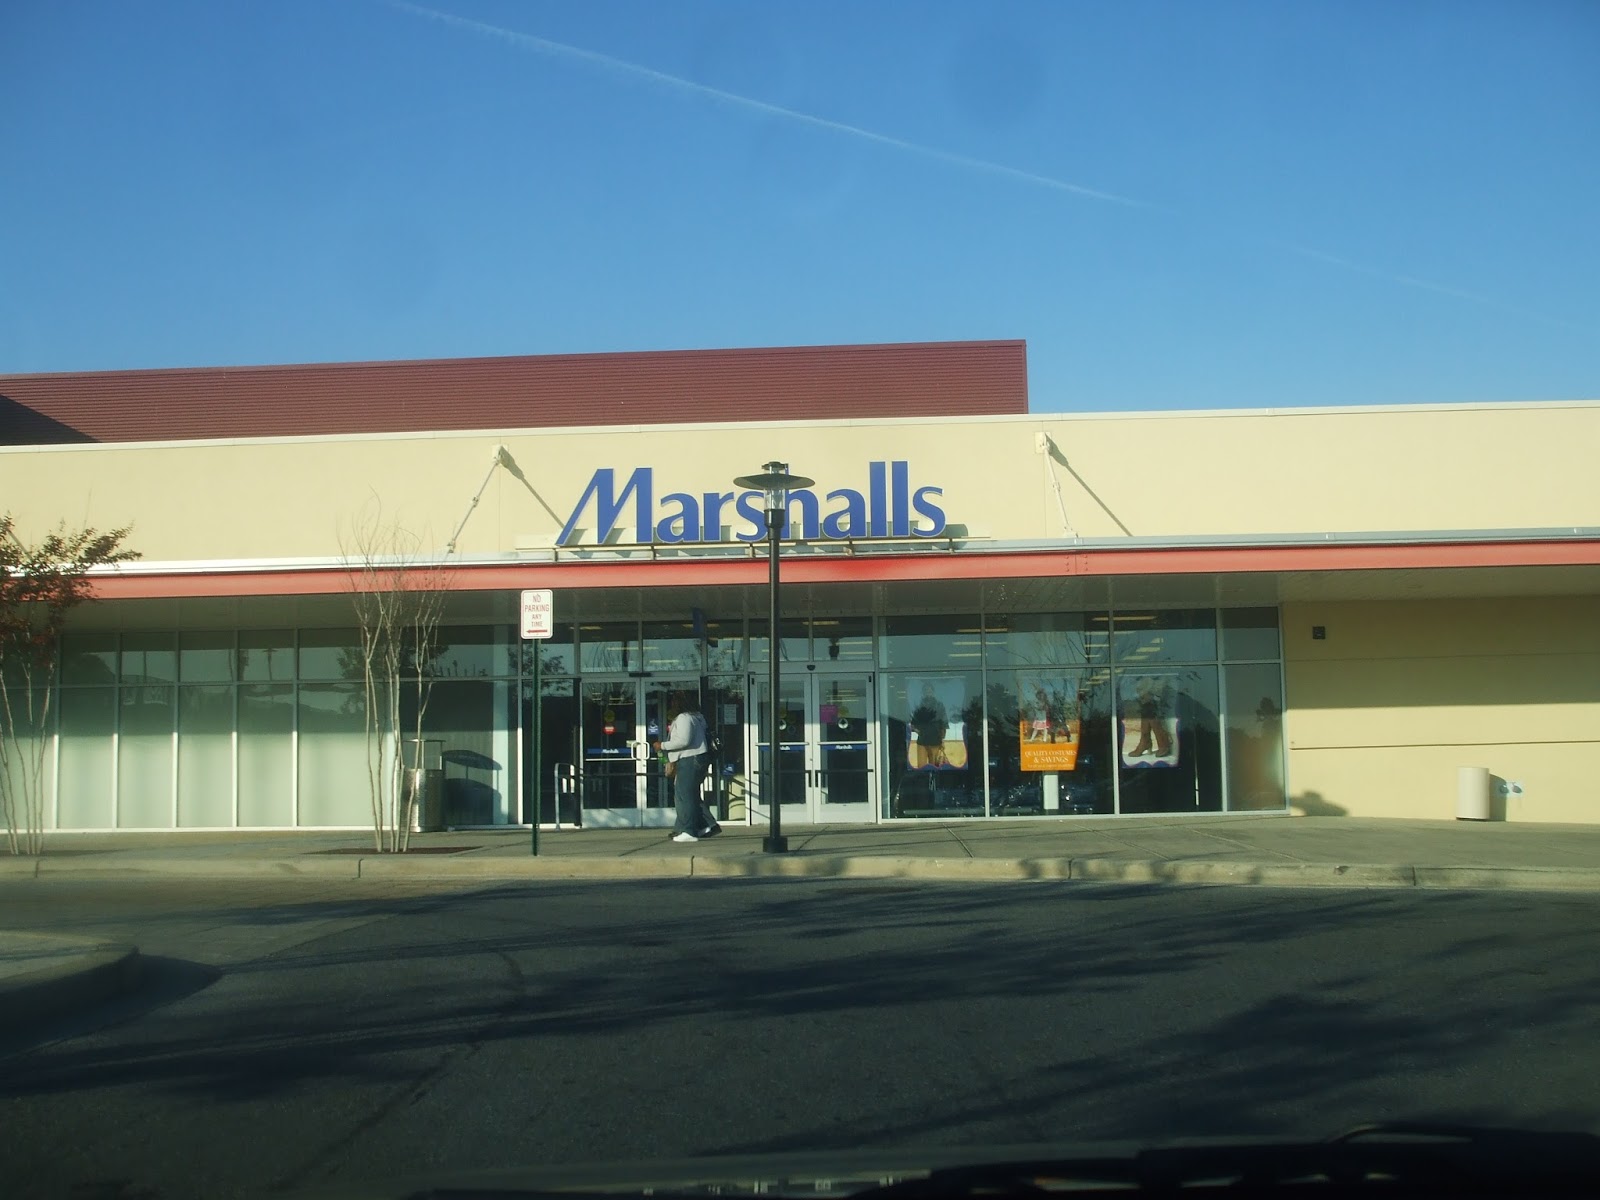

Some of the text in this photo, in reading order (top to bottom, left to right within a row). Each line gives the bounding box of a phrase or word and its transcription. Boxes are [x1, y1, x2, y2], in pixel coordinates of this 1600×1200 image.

[555, 460, 947, 546] Marshalls
[532, 593, 541, 602] NO
[524, 604, 550, 612] PARKING
[1024, 750, 1048, 758] QUALITY
